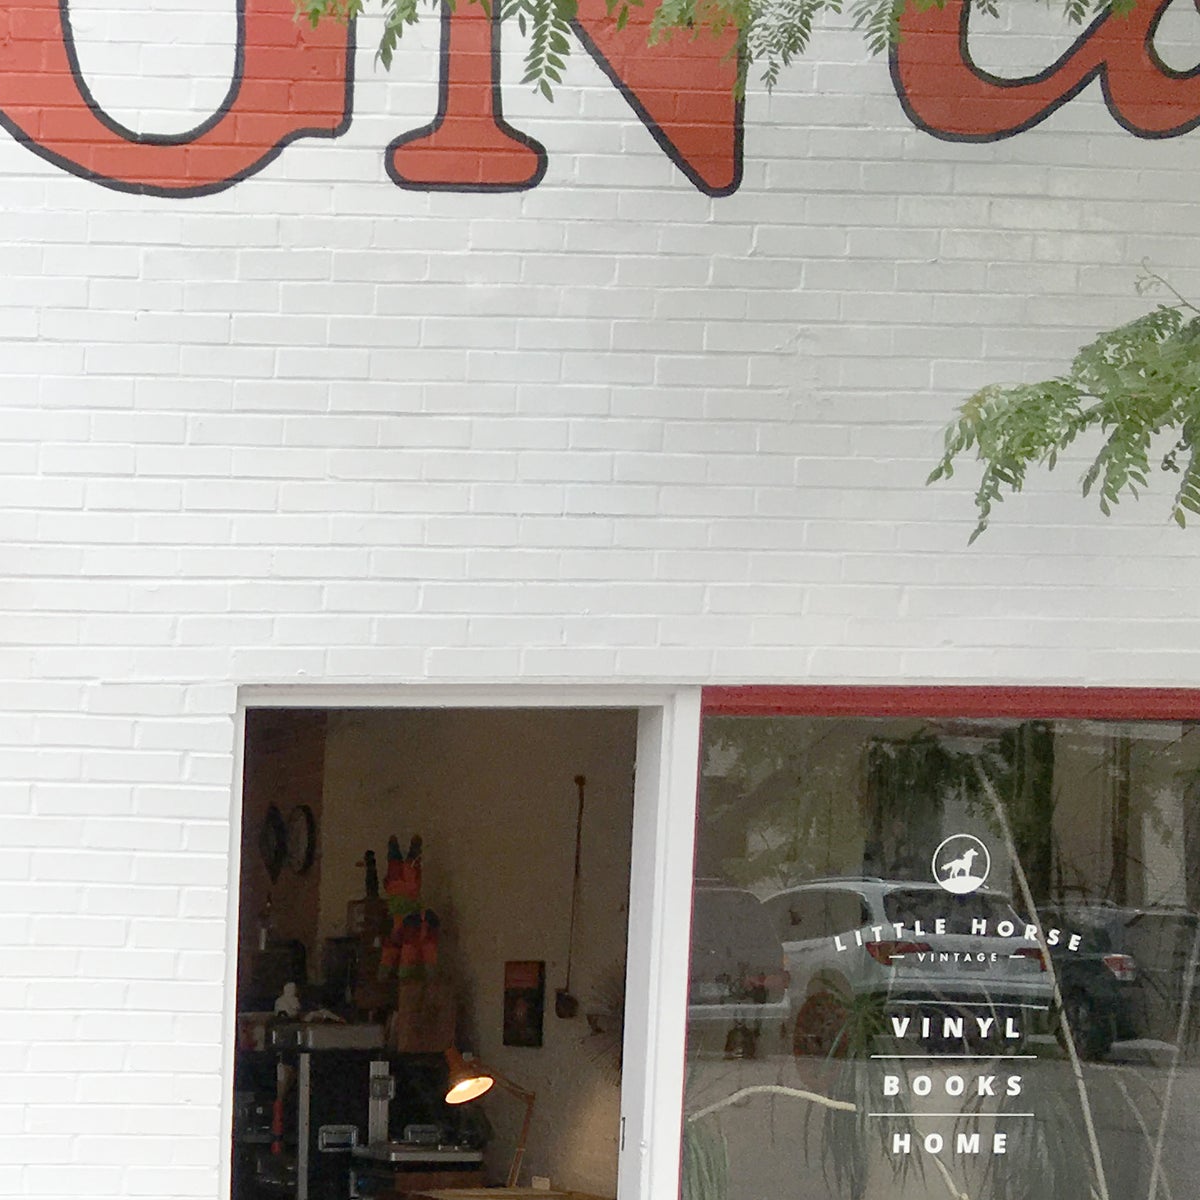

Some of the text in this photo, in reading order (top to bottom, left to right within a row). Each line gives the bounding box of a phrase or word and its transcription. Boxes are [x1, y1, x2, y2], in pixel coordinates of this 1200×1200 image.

[833, 918, 1083, 953] LITTLE HORSE
[917, 952, 998, 962] VINTAGE
[891, 1017, 1020, 1039] VINYL
[883, 1075, 1023, 1097] BOOKS
[892, 1133, 1007, 1155] HOME
